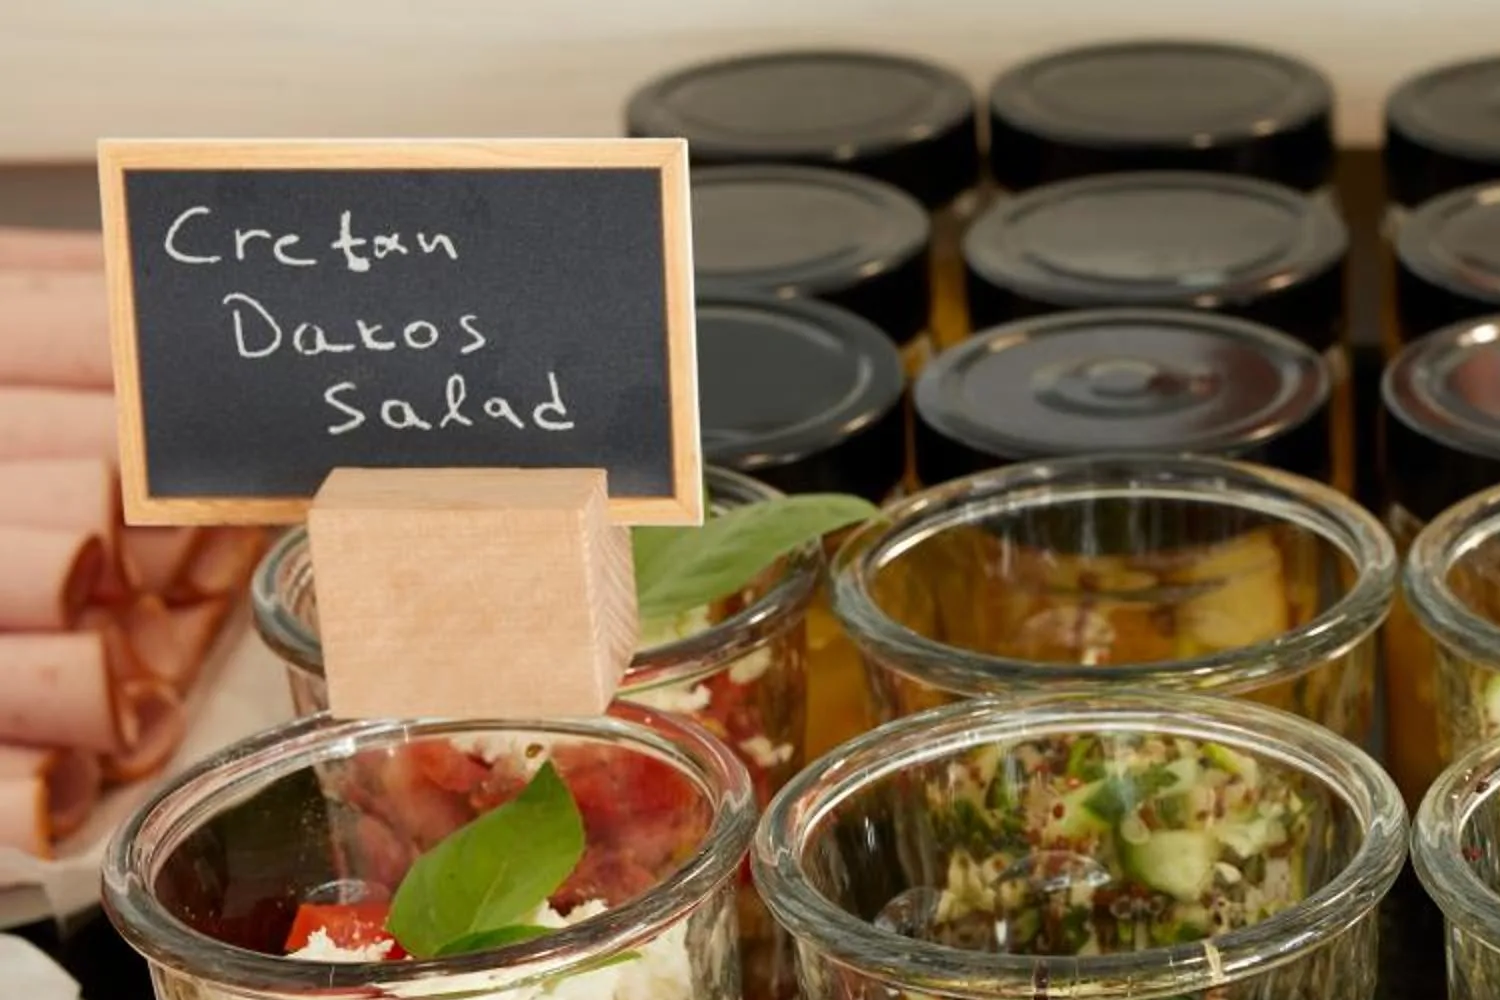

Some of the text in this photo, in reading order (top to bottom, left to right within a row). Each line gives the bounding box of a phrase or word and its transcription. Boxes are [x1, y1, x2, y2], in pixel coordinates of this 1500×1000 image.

[163, 205, 459, 272] Cretan
[222, 292, 487, 358] Dakos
[323, 370, 576, 435] Salad
